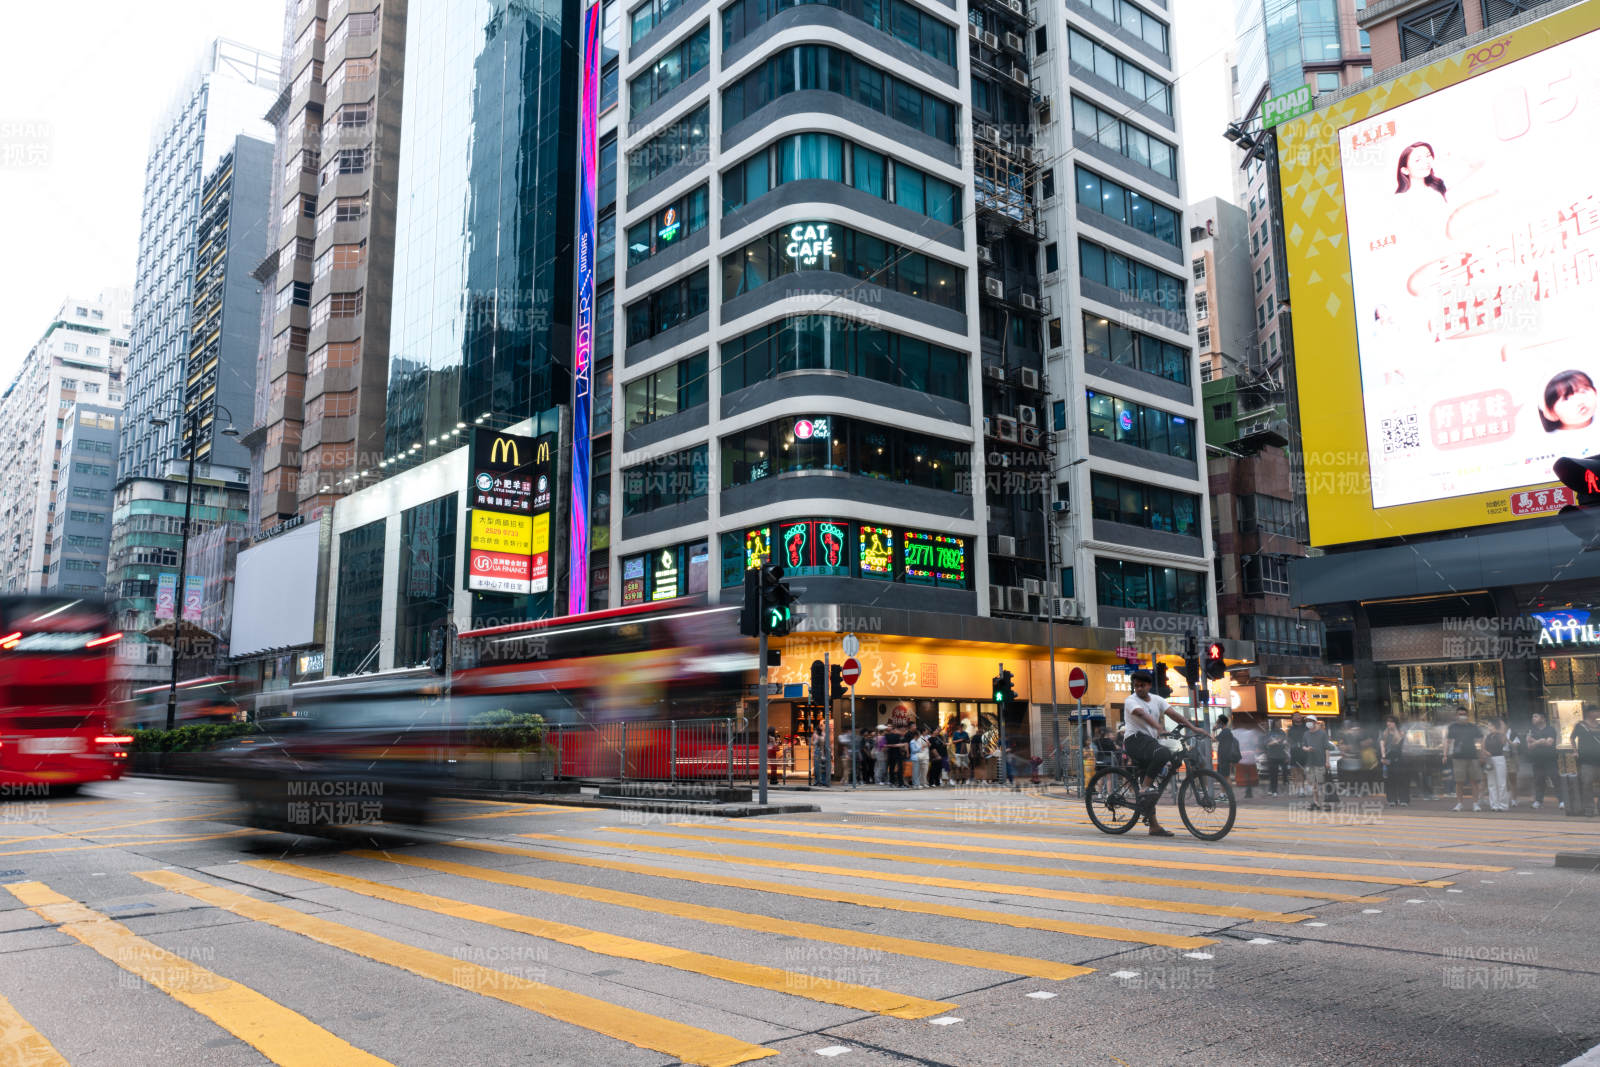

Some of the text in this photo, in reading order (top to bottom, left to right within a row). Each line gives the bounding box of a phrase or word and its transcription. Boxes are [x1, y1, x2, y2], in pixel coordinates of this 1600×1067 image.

[1264, 87, 1309, 119] POAD
[790, 225, 828, 241] CAT
[786, 237, 833, 258] CAFÉ
[803, 257, 817, 265] 4/F
[576, 294, 591, 397] LADDER
[494, 478, 521, 490] 小肥羊
[1518, 488, 1568, 509] 馬百良
[865, 556, 888, 567] FOOT
[908, 543, 934, 567] 2771
